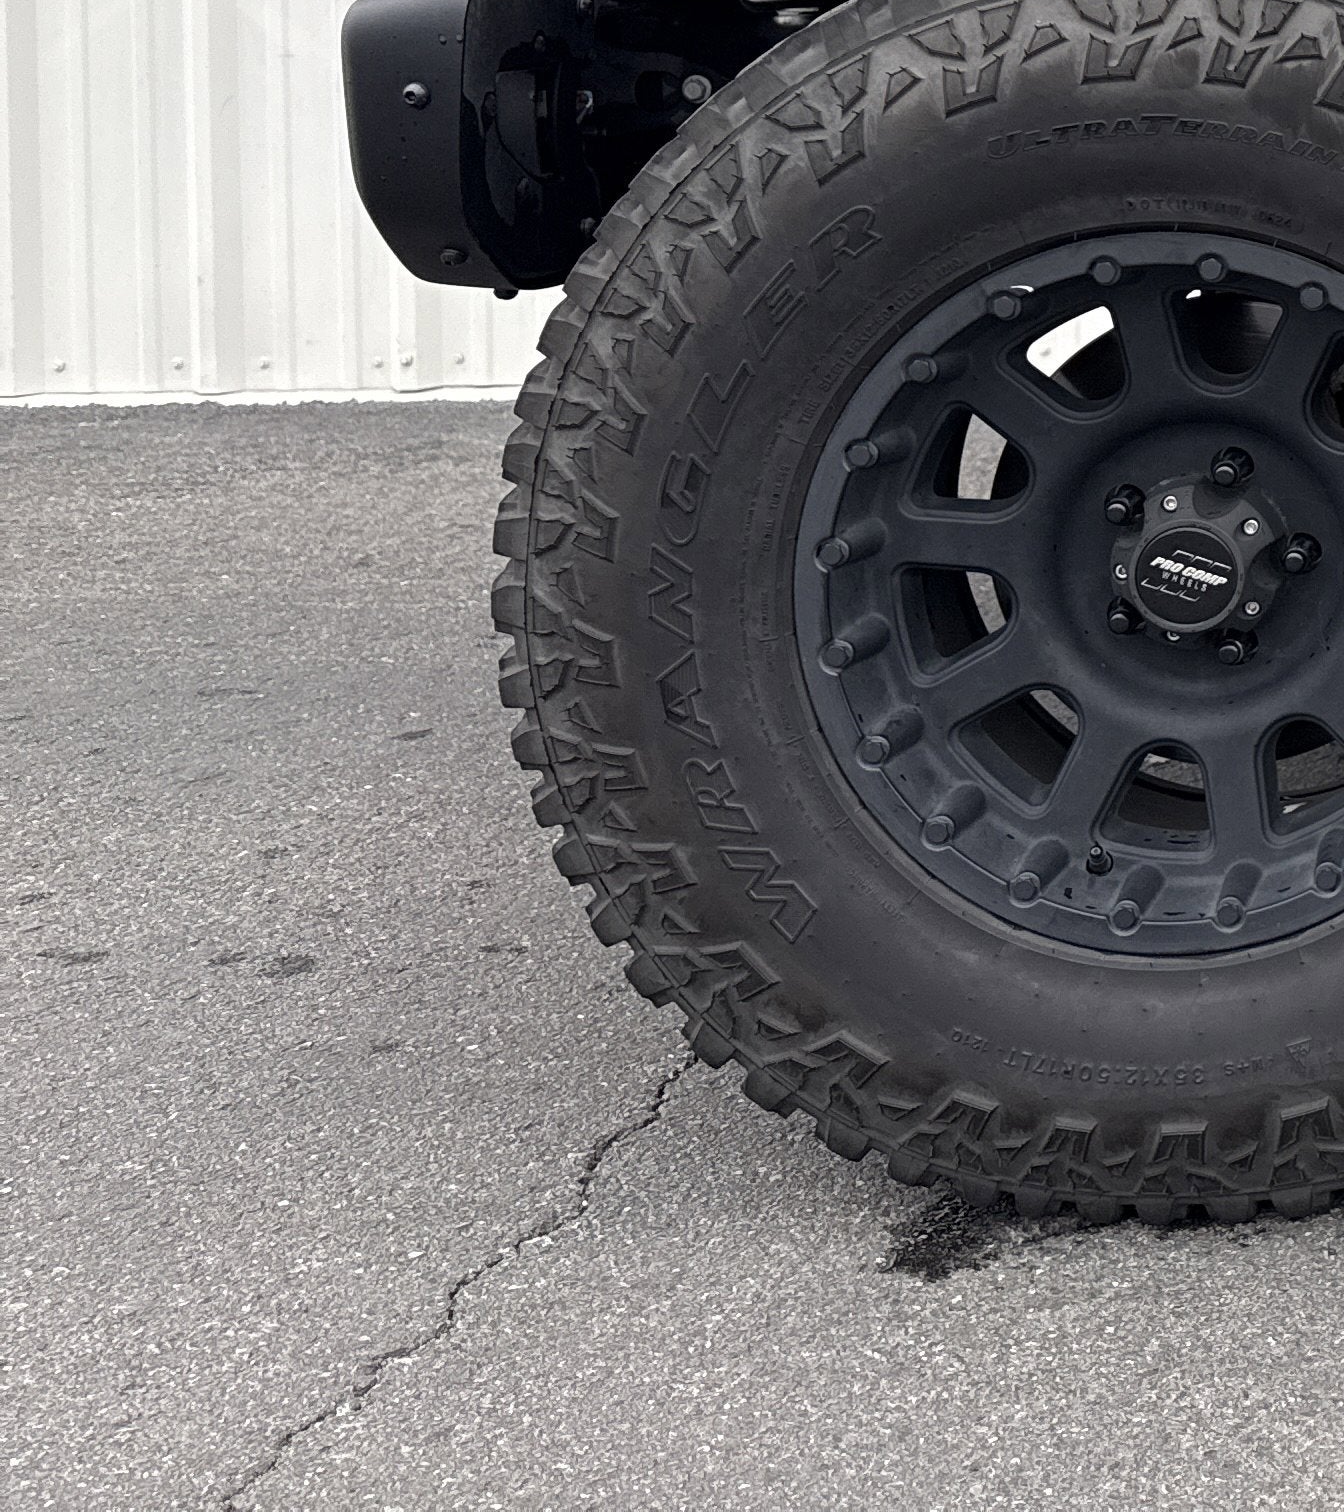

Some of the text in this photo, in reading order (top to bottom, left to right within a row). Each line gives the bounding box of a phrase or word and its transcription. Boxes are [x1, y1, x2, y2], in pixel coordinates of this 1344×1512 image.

[648, 203, 883, 943] WRANGLER
[1150, 556, 1228, 586] PRO COMP
[1161, 571, 1208, 592] WHEELS
